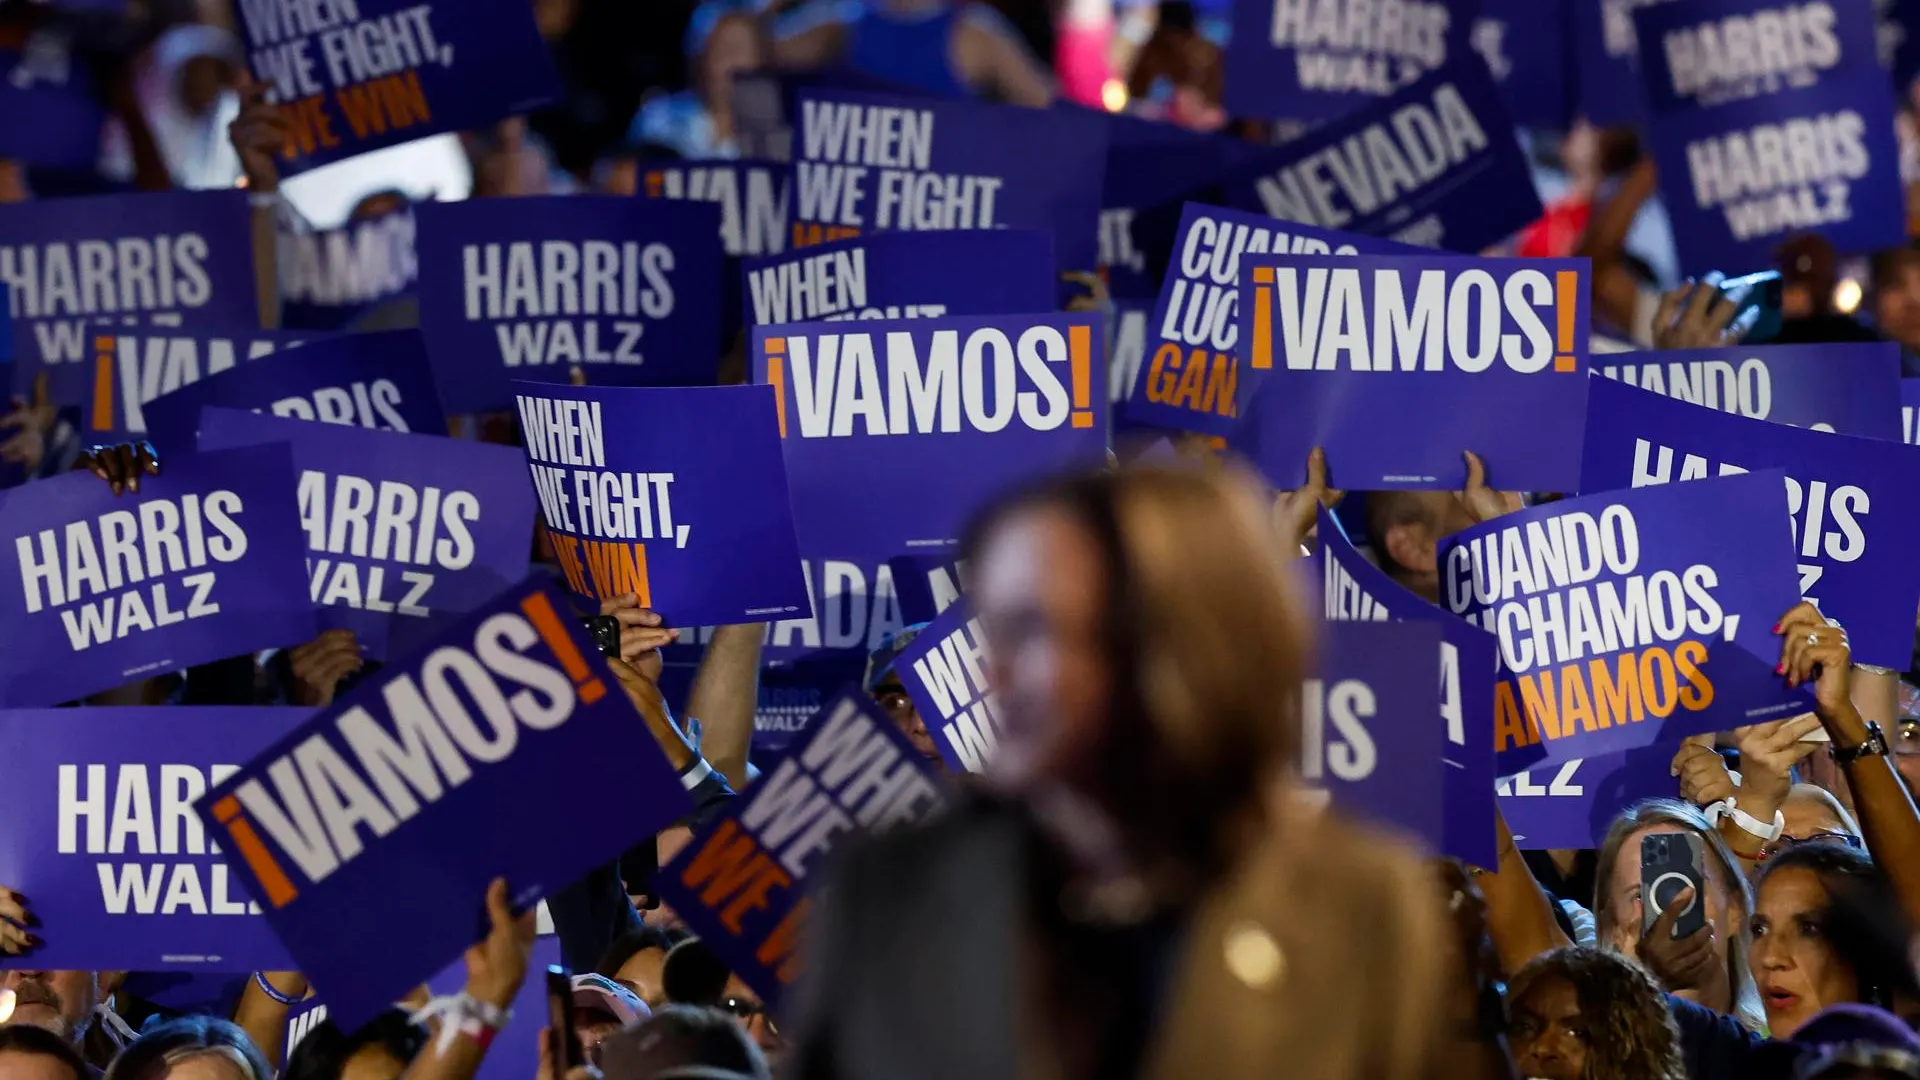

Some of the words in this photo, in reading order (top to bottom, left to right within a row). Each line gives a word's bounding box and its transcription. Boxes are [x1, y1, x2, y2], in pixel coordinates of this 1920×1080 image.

[321, 5, 454, 86] FIGHT,
[1271, 0, 1450, 70] HARRIS
[1665, 2, 1840, 96] HARRIS
[334, 68, 432, 139] WIN
[802, 100, 934, 170] WHEN
[797, 161, 867, 226] WE
[876, 168, 1008, 231] FIGHT
[1255, 83, 1488, 228] NEVADA
[1687, 111, 1870, 208] HARRIS
[1723, 182, 1850, 241] WALZ
[0, 232, 212, 319] HARRIS
[463, 239, 676, 321] HARRIS
[749, 247, 867, 325] WHEN
[495, 319, 645, 368] WALZ
[1251, 266, 1579, 373] ¡VAMOS!
[765, 325, 1093, 438] ¡VAMOS!
[516, 395, 606, 468] WHEN
[297, 469, 480, 572] ARRIS
[529, 463, 576, 534] WE
[574, 470, 691, 549] FIGHT,
[15, 489, 248, 614] HARRIS
[547, 530, 595, 600] WE
[582, 542, 652, 609] WIN
[1447, 503, 1640, 615] CUANDO
[60, 571, 220, 652] WALZ
[1466, 564, 1741, 674] CHAMOS,
[1494, 640, 1715, 752] ANAMOS
[210, 590, 608, 909] ¡VAMOS!
[741, 757, 854, 880] WE
[96, 863, 263, 916] WAL
[681, 817, 792, 936] WE
